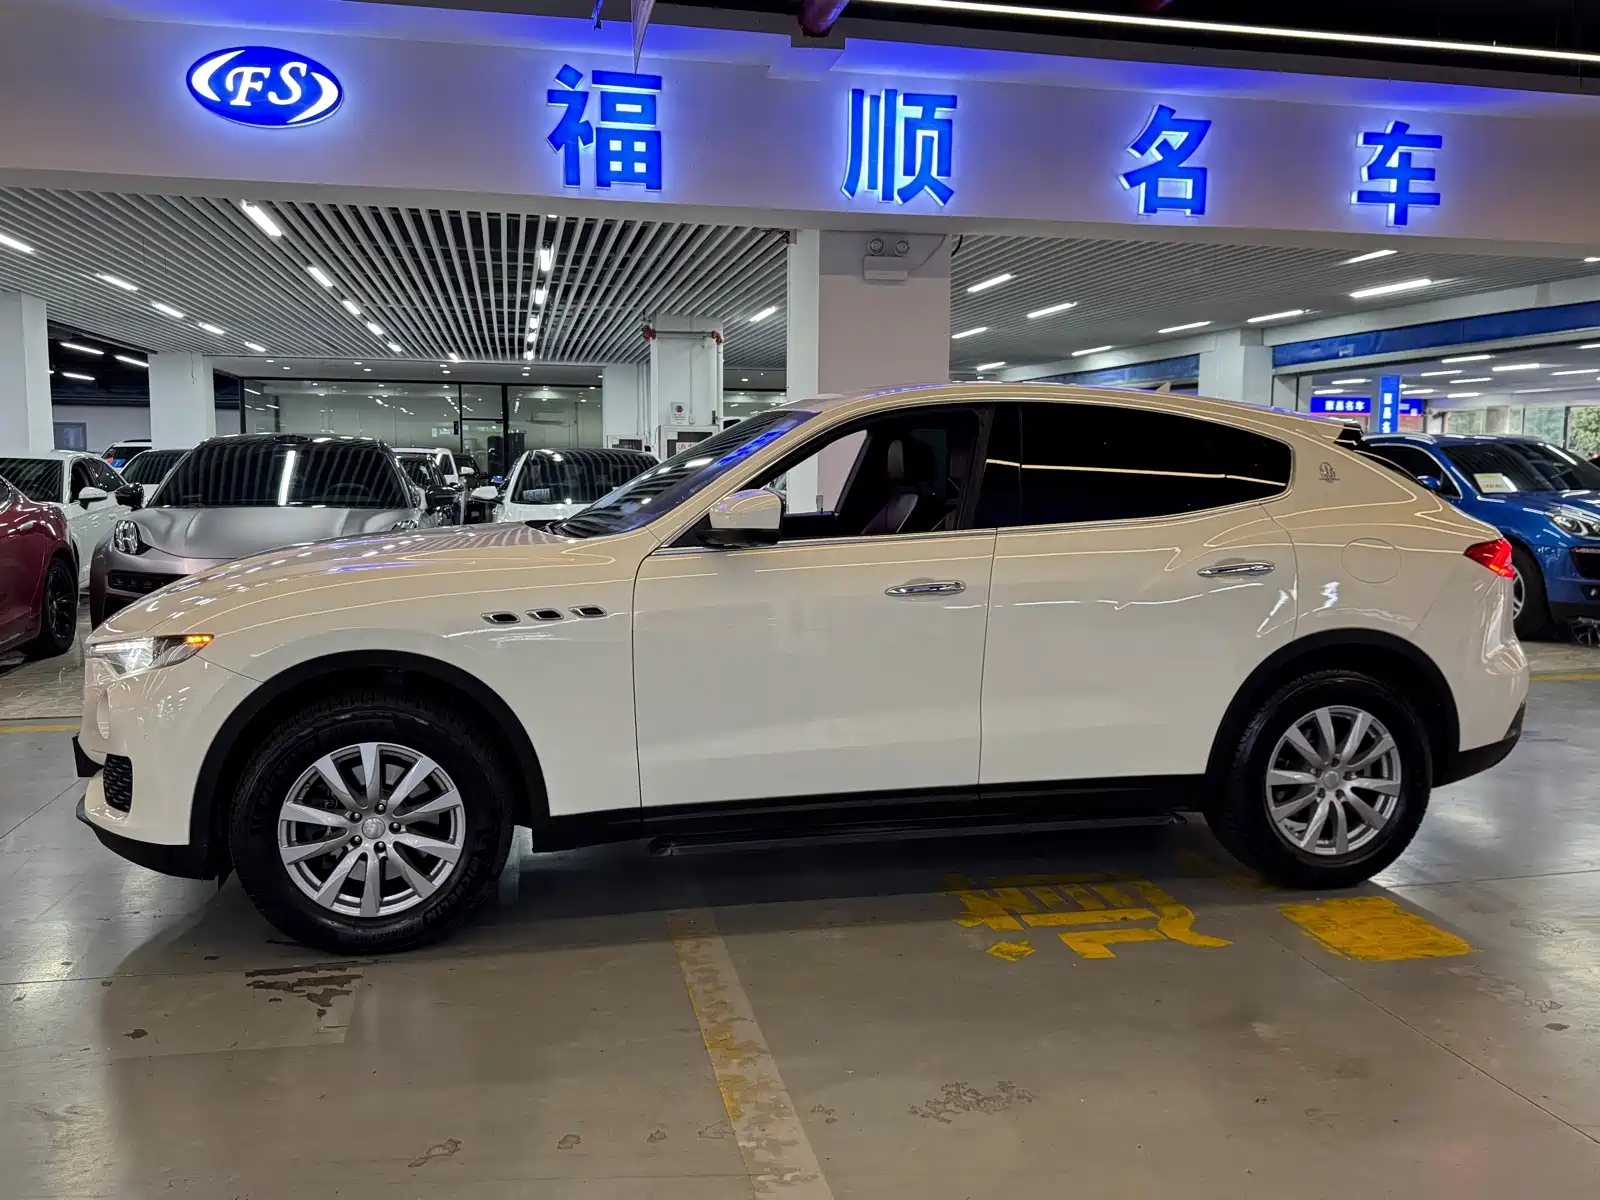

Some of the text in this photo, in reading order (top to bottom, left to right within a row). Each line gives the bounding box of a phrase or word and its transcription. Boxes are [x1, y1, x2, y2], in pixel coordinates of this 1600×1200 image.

[225, 61, 307, 107] FS
[545, 63, 1443, 226] 福顺名车
